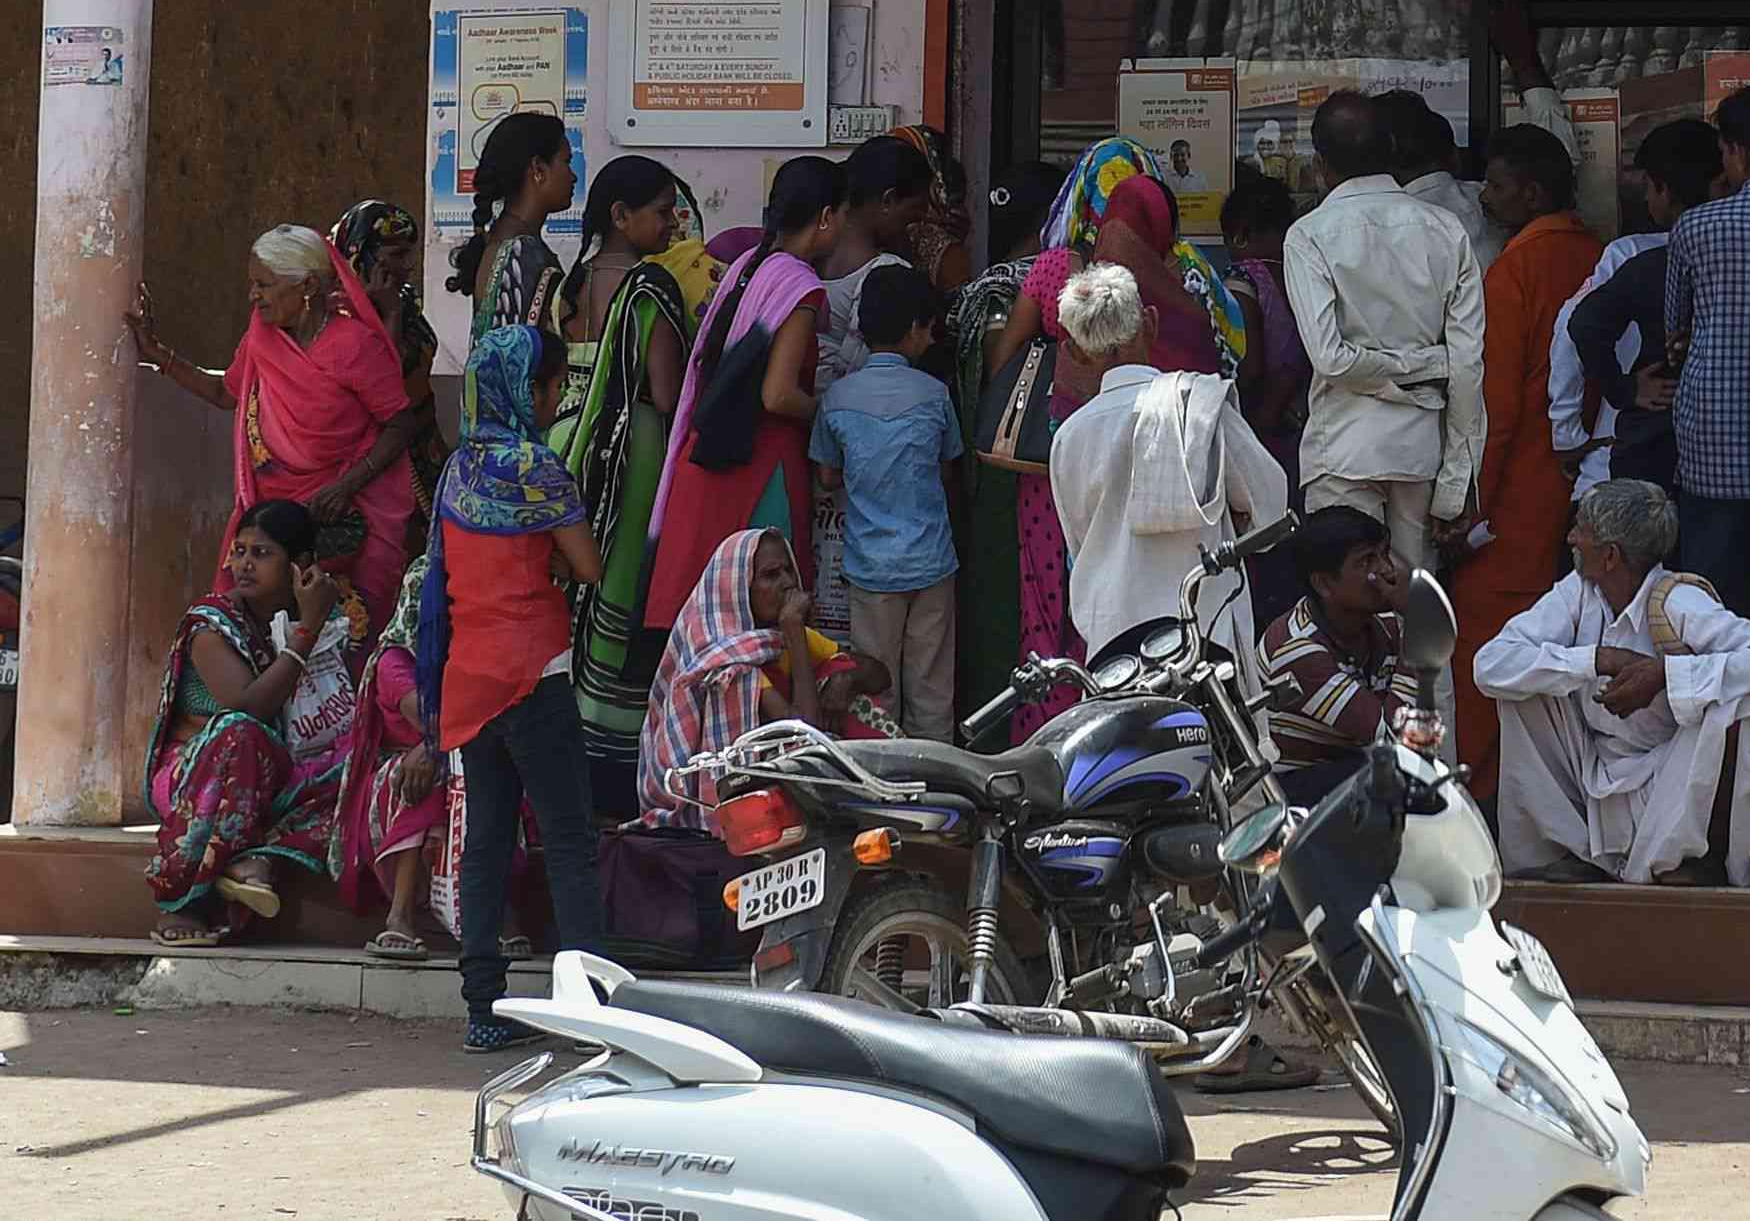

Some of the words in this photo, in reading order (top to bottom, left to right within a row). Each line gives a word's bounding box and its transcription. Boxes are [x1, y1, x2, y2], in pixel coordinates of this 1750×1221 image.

[468, 28, 497, 37] Aadhaar
[499, 27, 537, 35] Awareness
[498, 63, 525, 71] Aadhaar
[1175, 726, 1207, 744] Hero
[752, 871, 774, 895] AP
[776, 865, 793, 885] 30
[797, 858, 809, 878] R
[745, 878, 817, 924] 2809
[557, 1138, 736, 1176] MAESTRO
